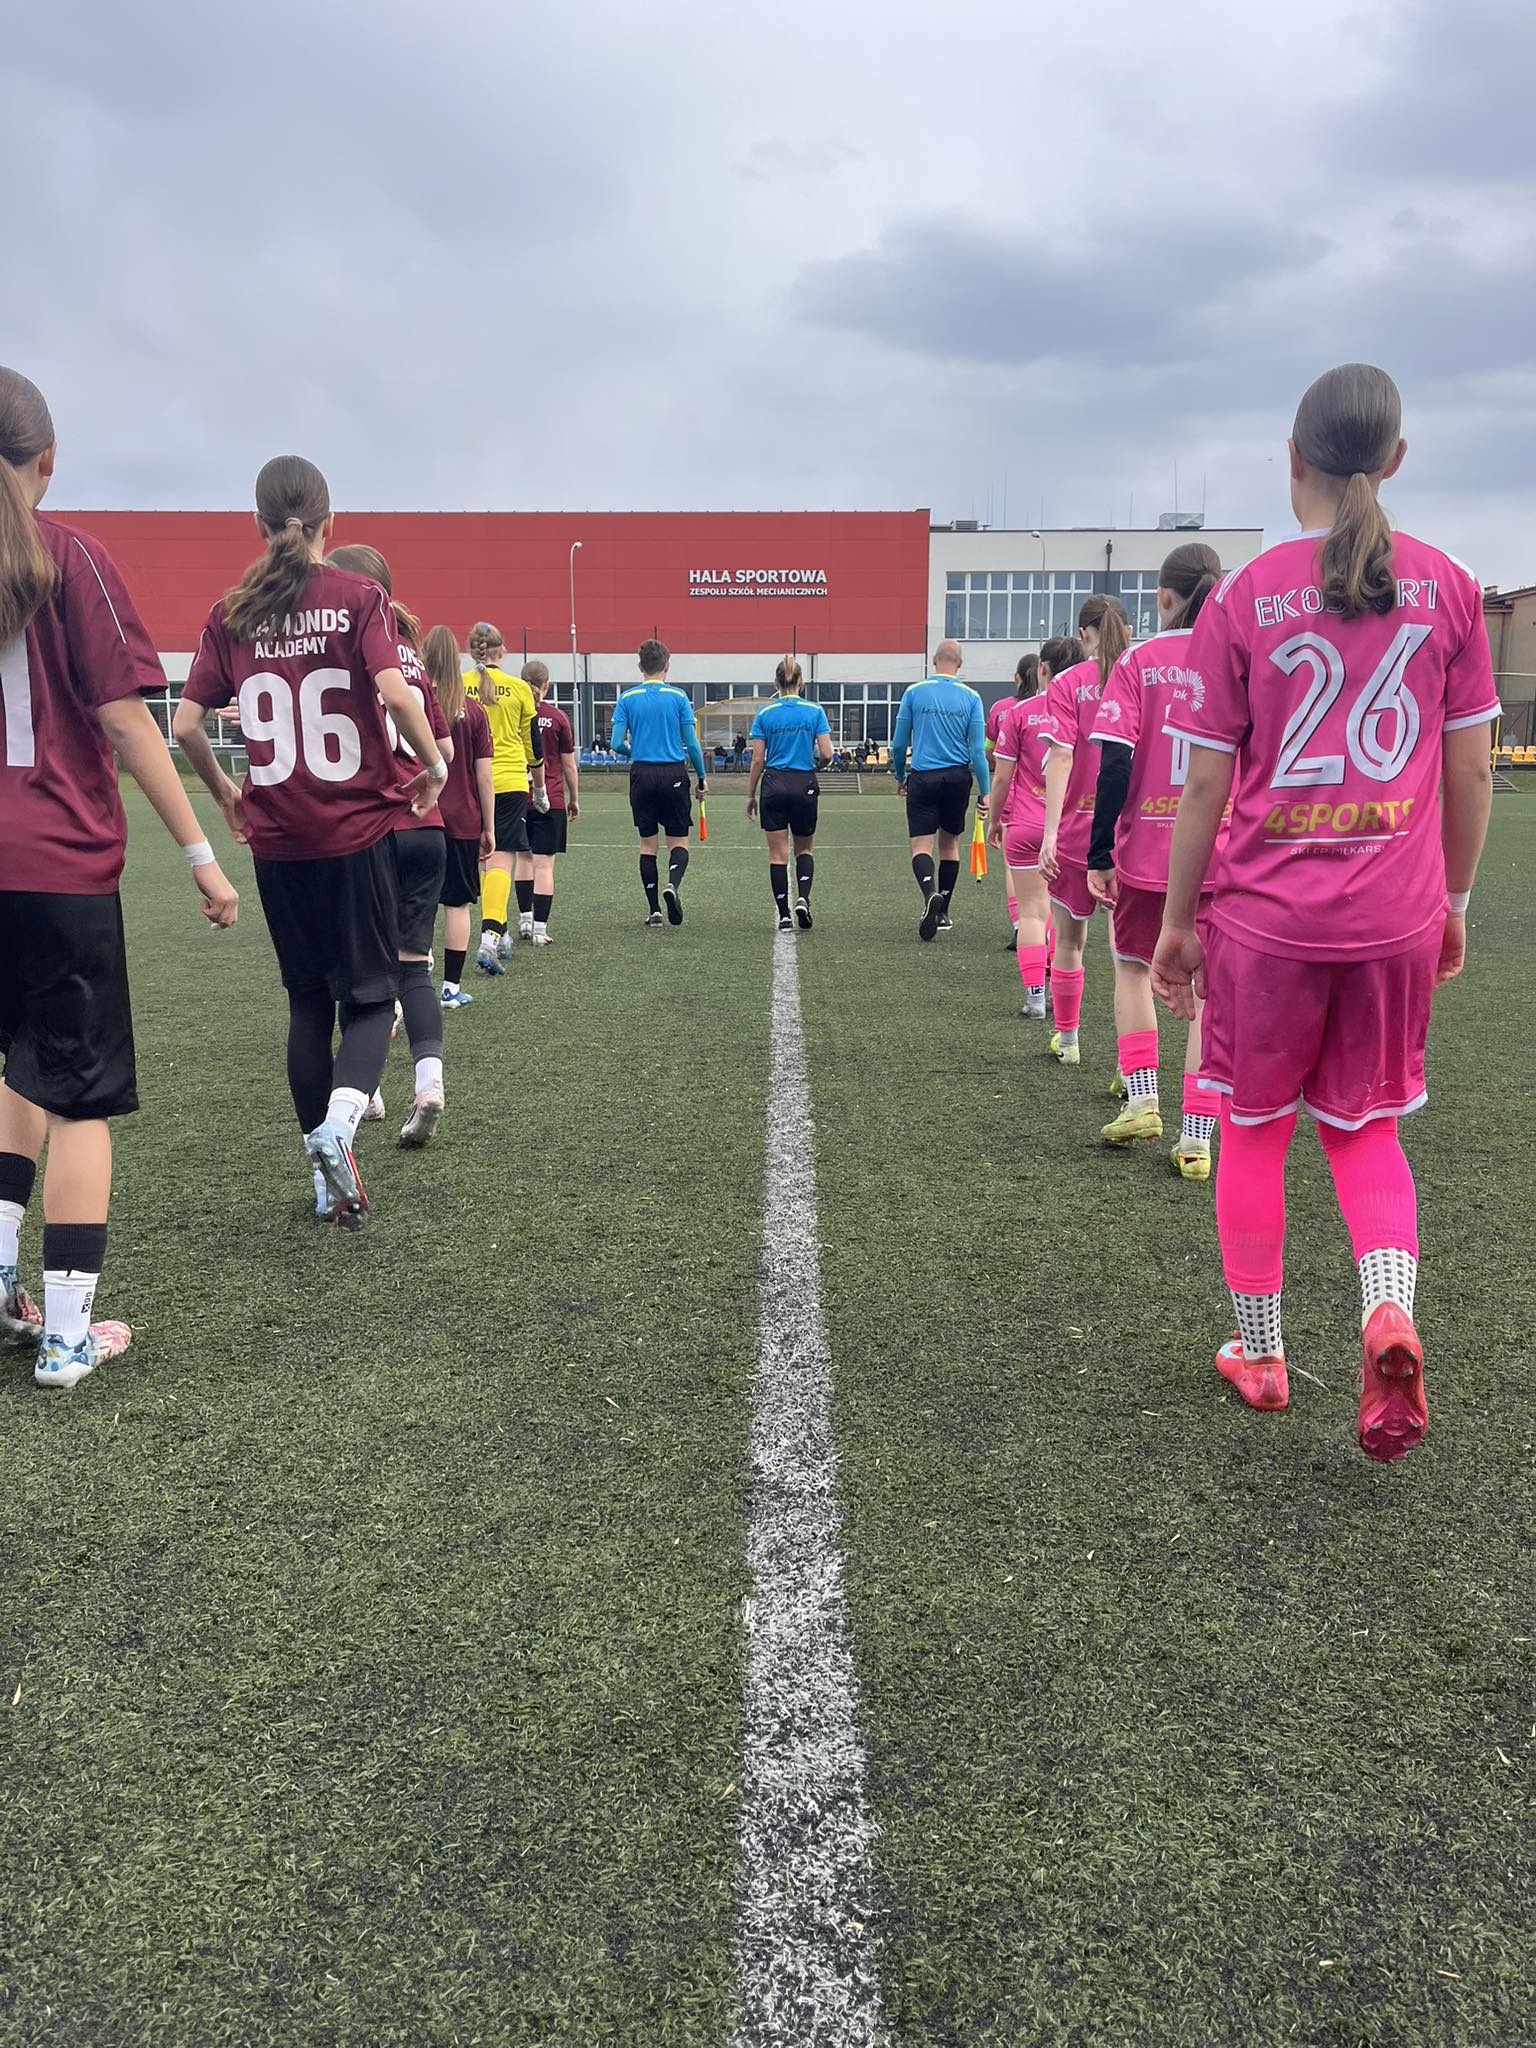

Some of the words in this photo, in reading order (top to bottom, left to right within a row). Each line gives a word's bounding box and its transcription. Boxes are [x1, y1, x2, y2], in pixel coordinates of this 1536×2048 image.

[689, 569, 731, 583] HALA
[735, 569, 827, 583] SPORTOWA
[689, 587, 727, 596] ZESPOŁU
[728, 586, 755, 596] SZKÓŁ
[756, 587, 828, 596] MECHANICZNYCH
[255, 636, 327, 659] ACADEMY
[1269, 623, 1433, 790] 26
[239, 667, 362, 786] 96
